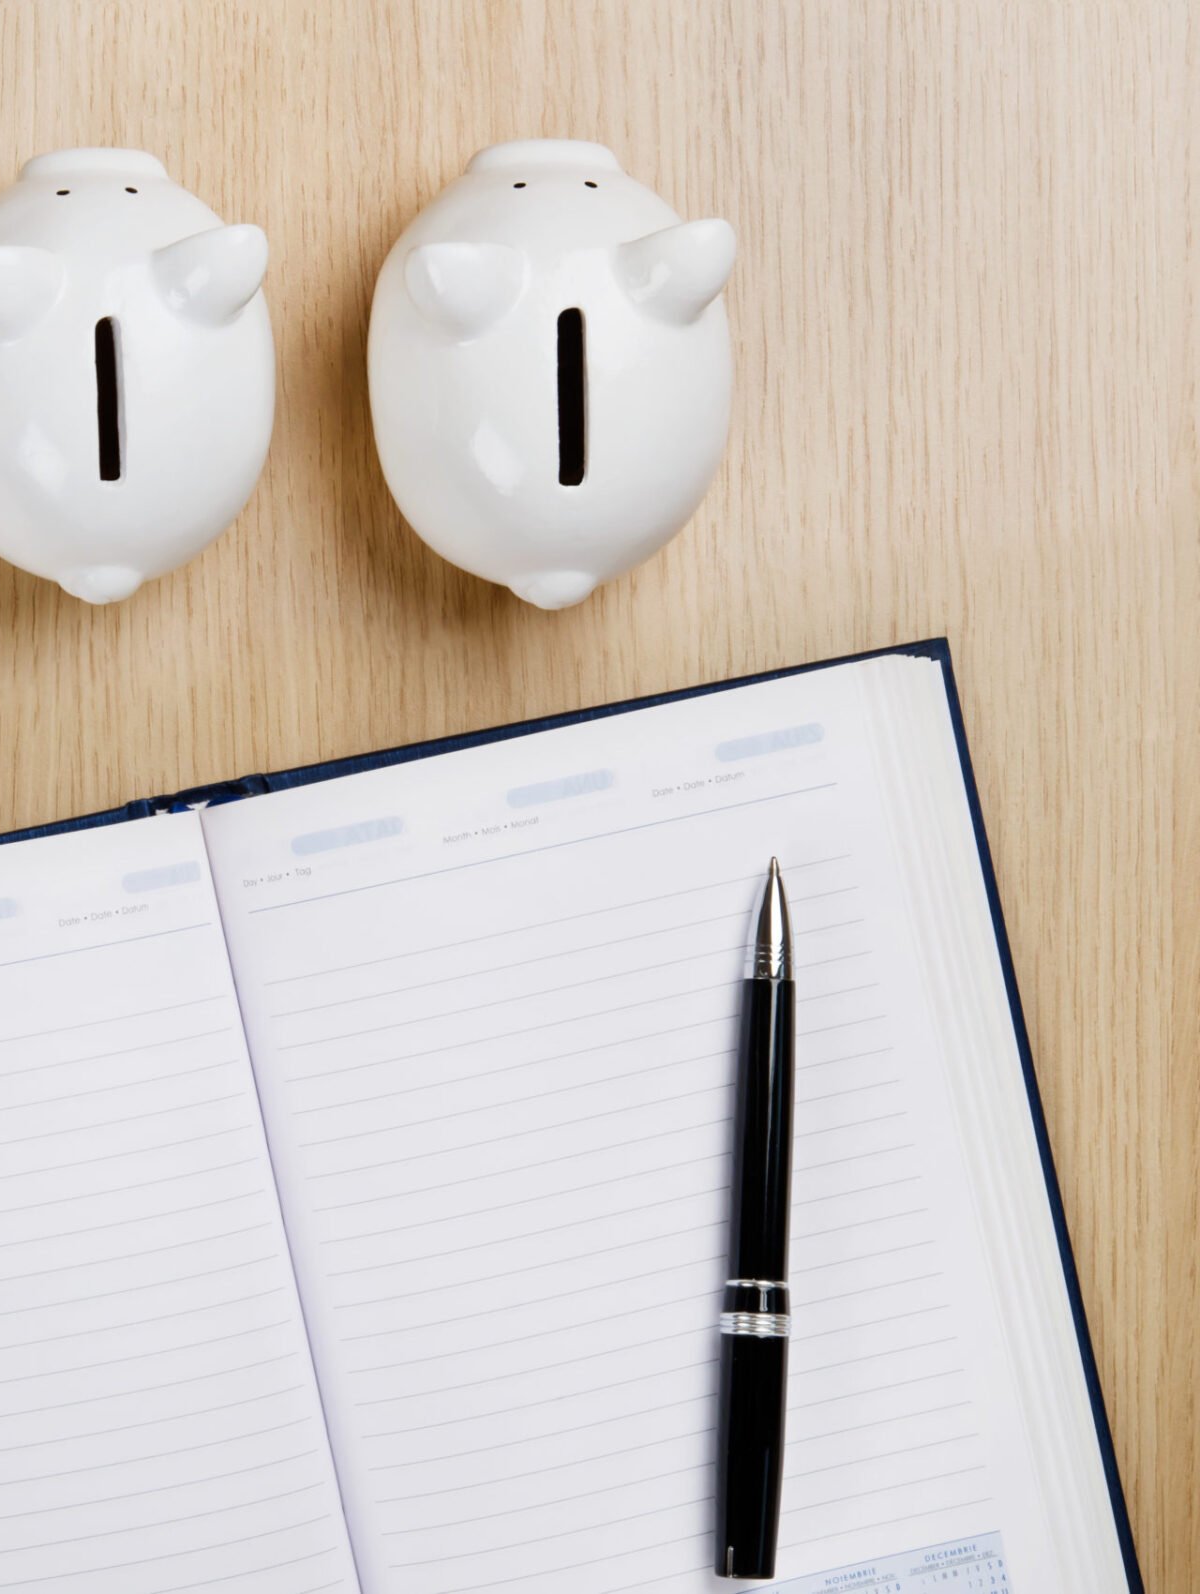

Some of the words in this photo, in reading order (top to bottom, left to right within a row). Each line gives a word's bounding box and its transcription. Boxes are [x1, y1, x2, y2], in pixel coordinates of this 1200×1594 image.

[652, 786, 674, 798] Date
[683, 780, 705, 791] Date
[715, 771, 745, 784] Datum
[442, 831, 471, 844] Month
[481, 825, 500, 836] Mois
[510, 816, 539, 829] Monat
[243, 879, 258, 888] Day
[294, 867, 312, 877] Tag
[58, 917, 80, 928] Date
[90, 909, 112, 921] Date
[121, 903, 150, 916] Datum
[924, 1544, 976, 1562] DECEMBRIE
[824, 1568, 876, 1586] NOIEMBRIE
